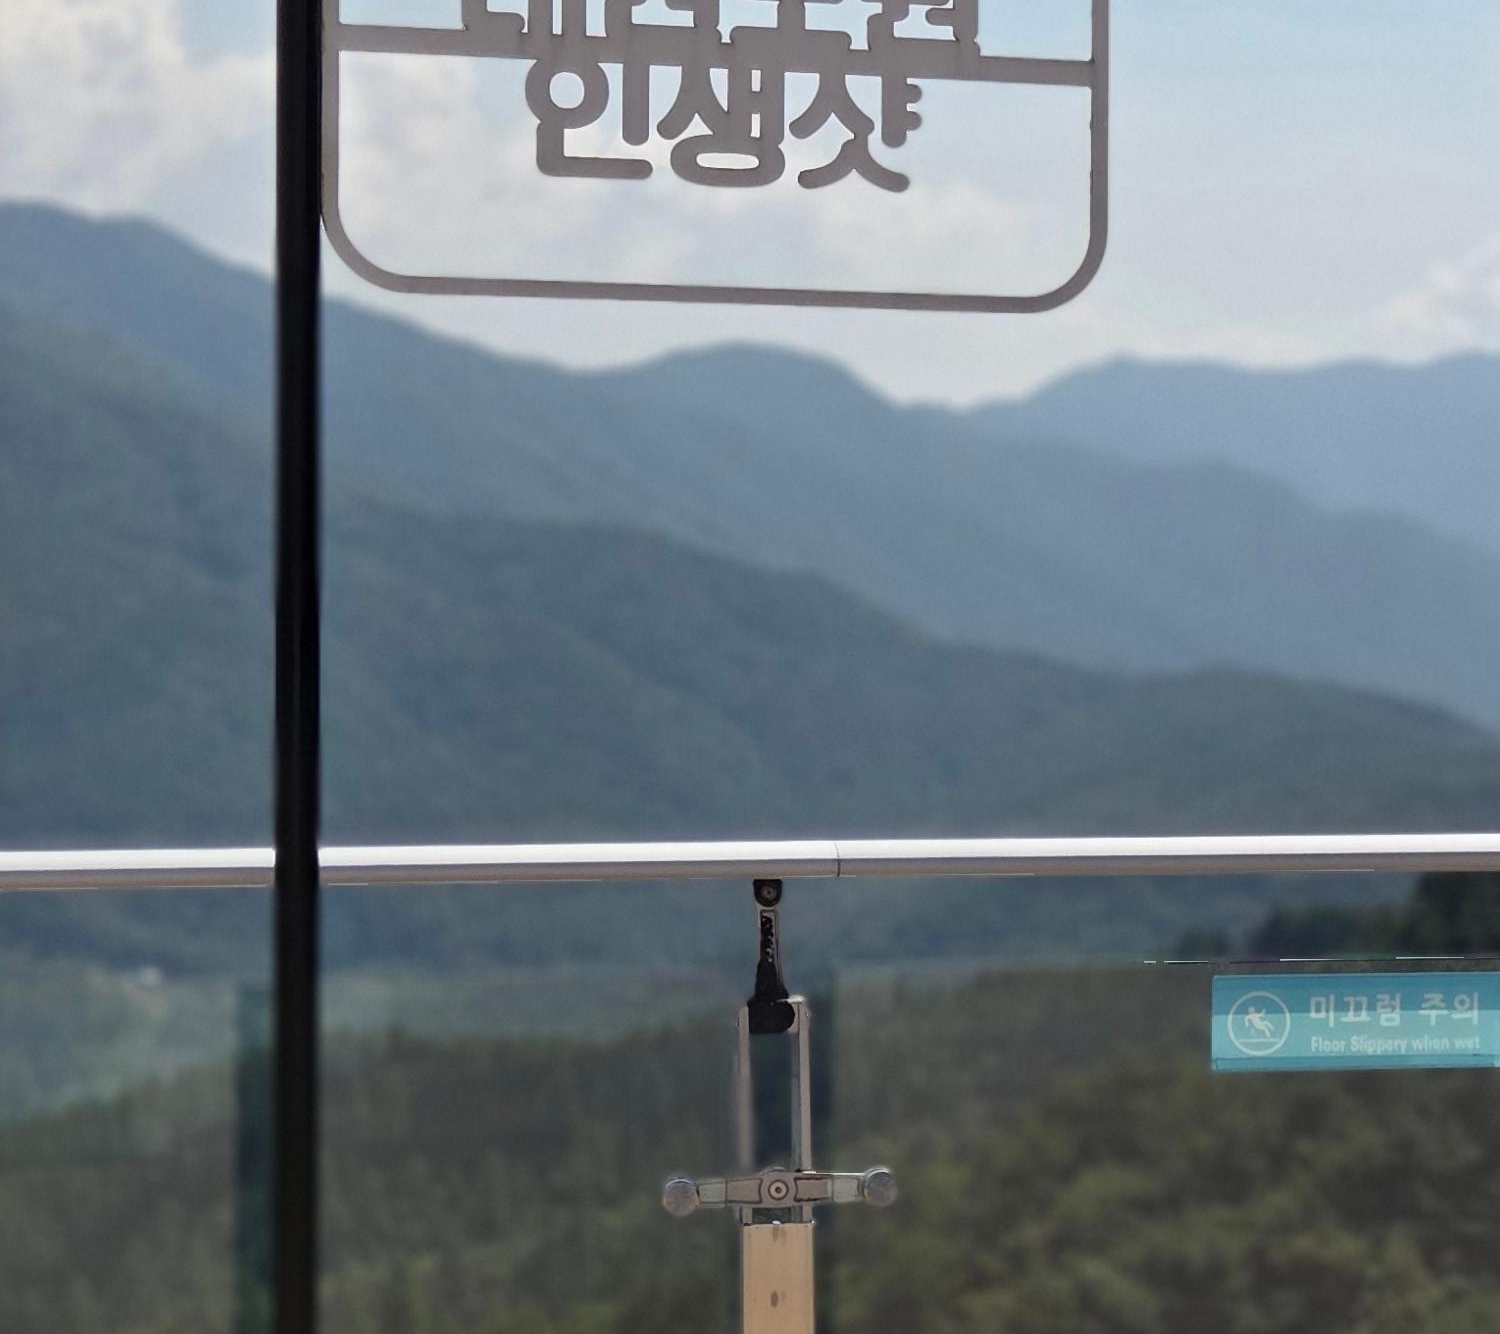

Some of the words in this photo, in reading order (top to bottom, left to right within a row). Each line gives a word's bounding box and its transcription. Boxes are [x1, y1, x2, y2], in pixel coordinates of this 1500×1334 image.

[524, 54, 923, 192] 인생샷
[1309, 992, 1401, 1028] 미끄럼
[1418, 991, 1479, 1026] 주의
[1311, 1035, 1346, 1053] Floor
[1350, 1034, 1408, 1055] Slippery
[1411, 1034, 1449, 1052] when
[1454, 1035, 1480, 1050] wet
